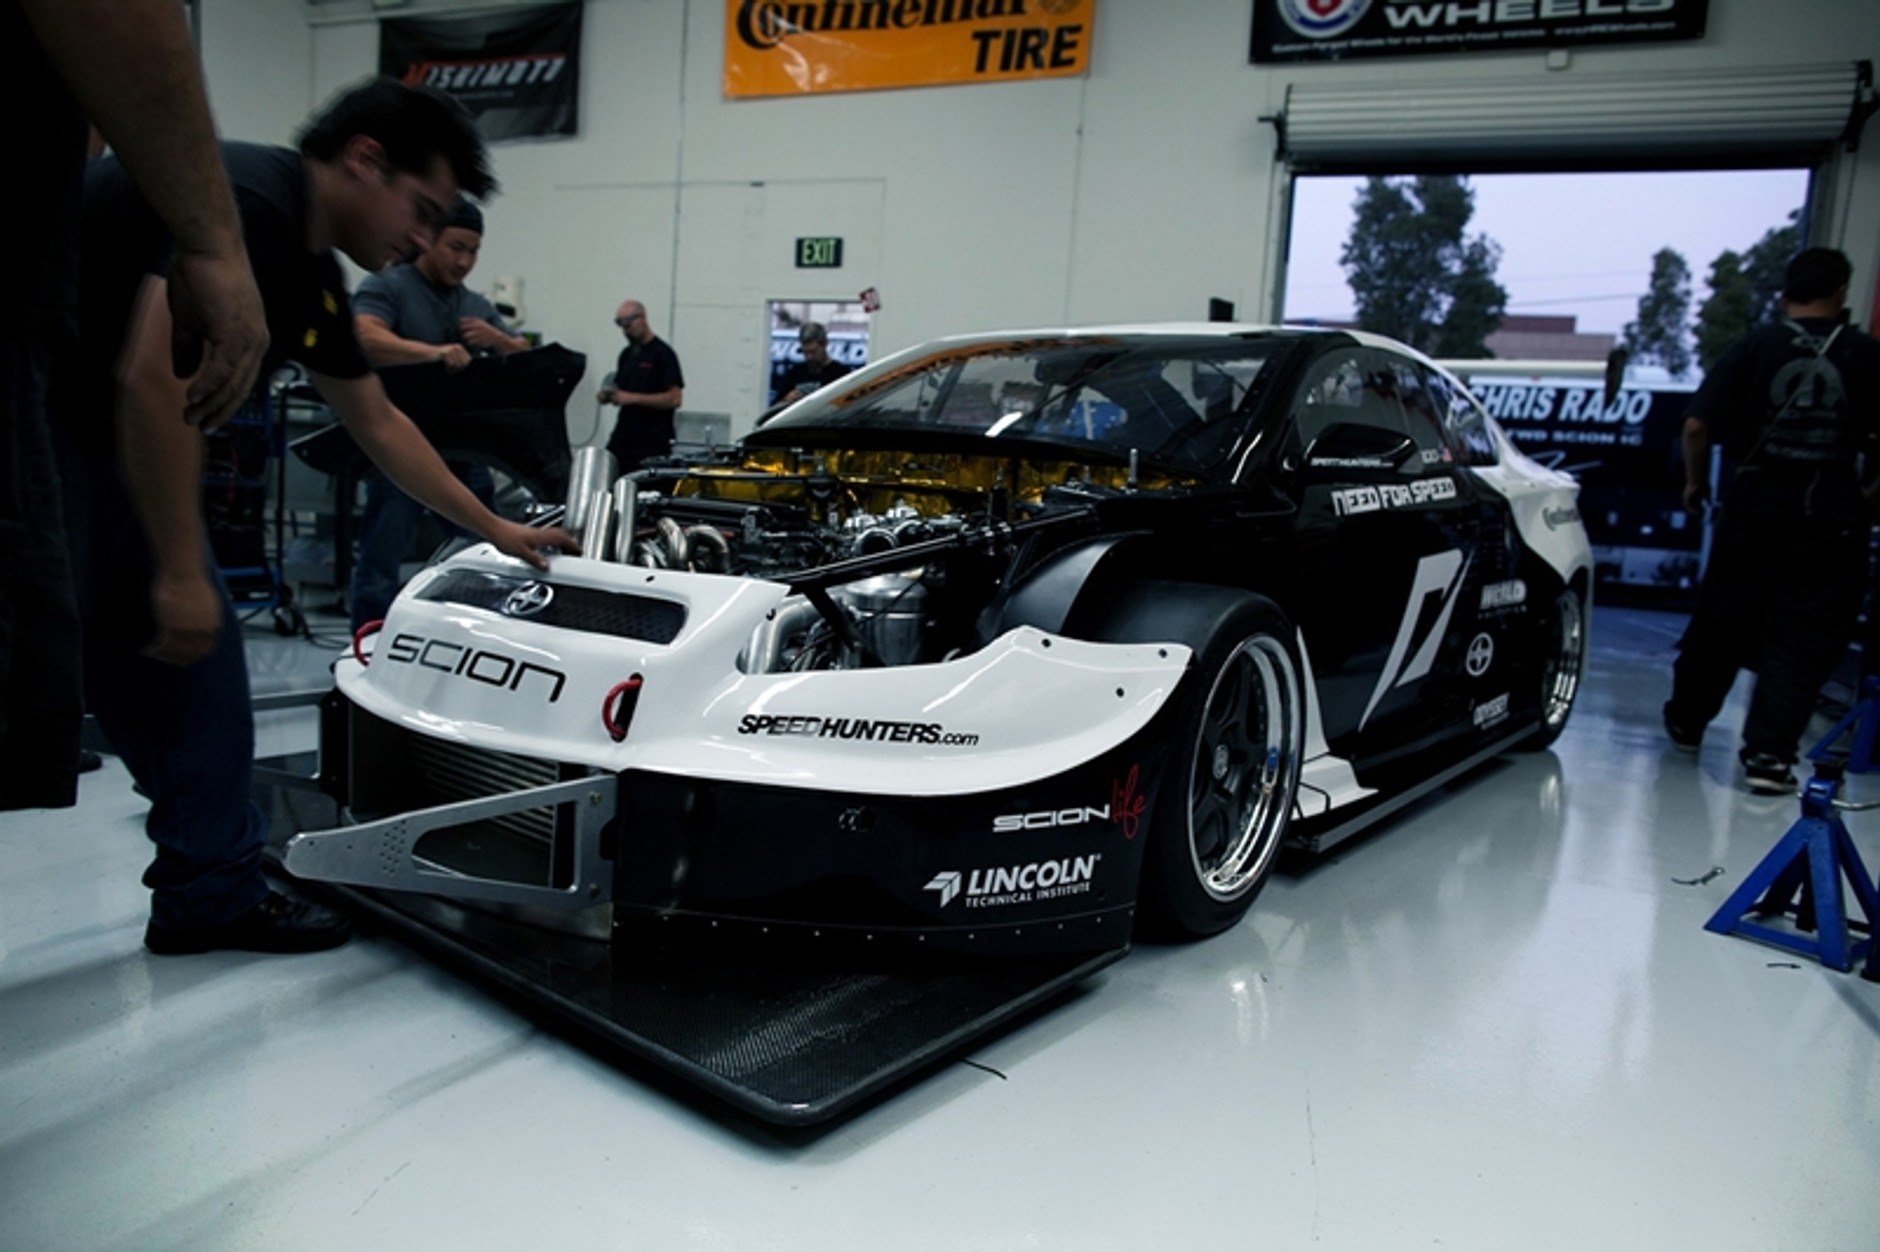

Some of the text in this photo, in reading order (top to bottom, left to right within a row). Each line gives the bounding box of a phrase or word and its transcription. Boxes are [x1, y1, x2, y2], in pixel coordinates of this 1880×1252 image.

[1384, 0, 1676, 29] WHEELS
[967, 24, 1083, 73] TIRE
[801, 239, 837, 265] EXIT
[1557, 389, 1654, 425] RADO
[1331, 476, 1458, 517] NEED FOR SPEED
[387, 633, 565, 703] SCION
[738, 715, 980, 746] SPEEDHUNTERS.com
[992, 803, 1111, 834] SCION
[966, 855, 1096, 897] LINCOLN
[965, 881, 1091, 909] TECHNICAL INSTITUTE
